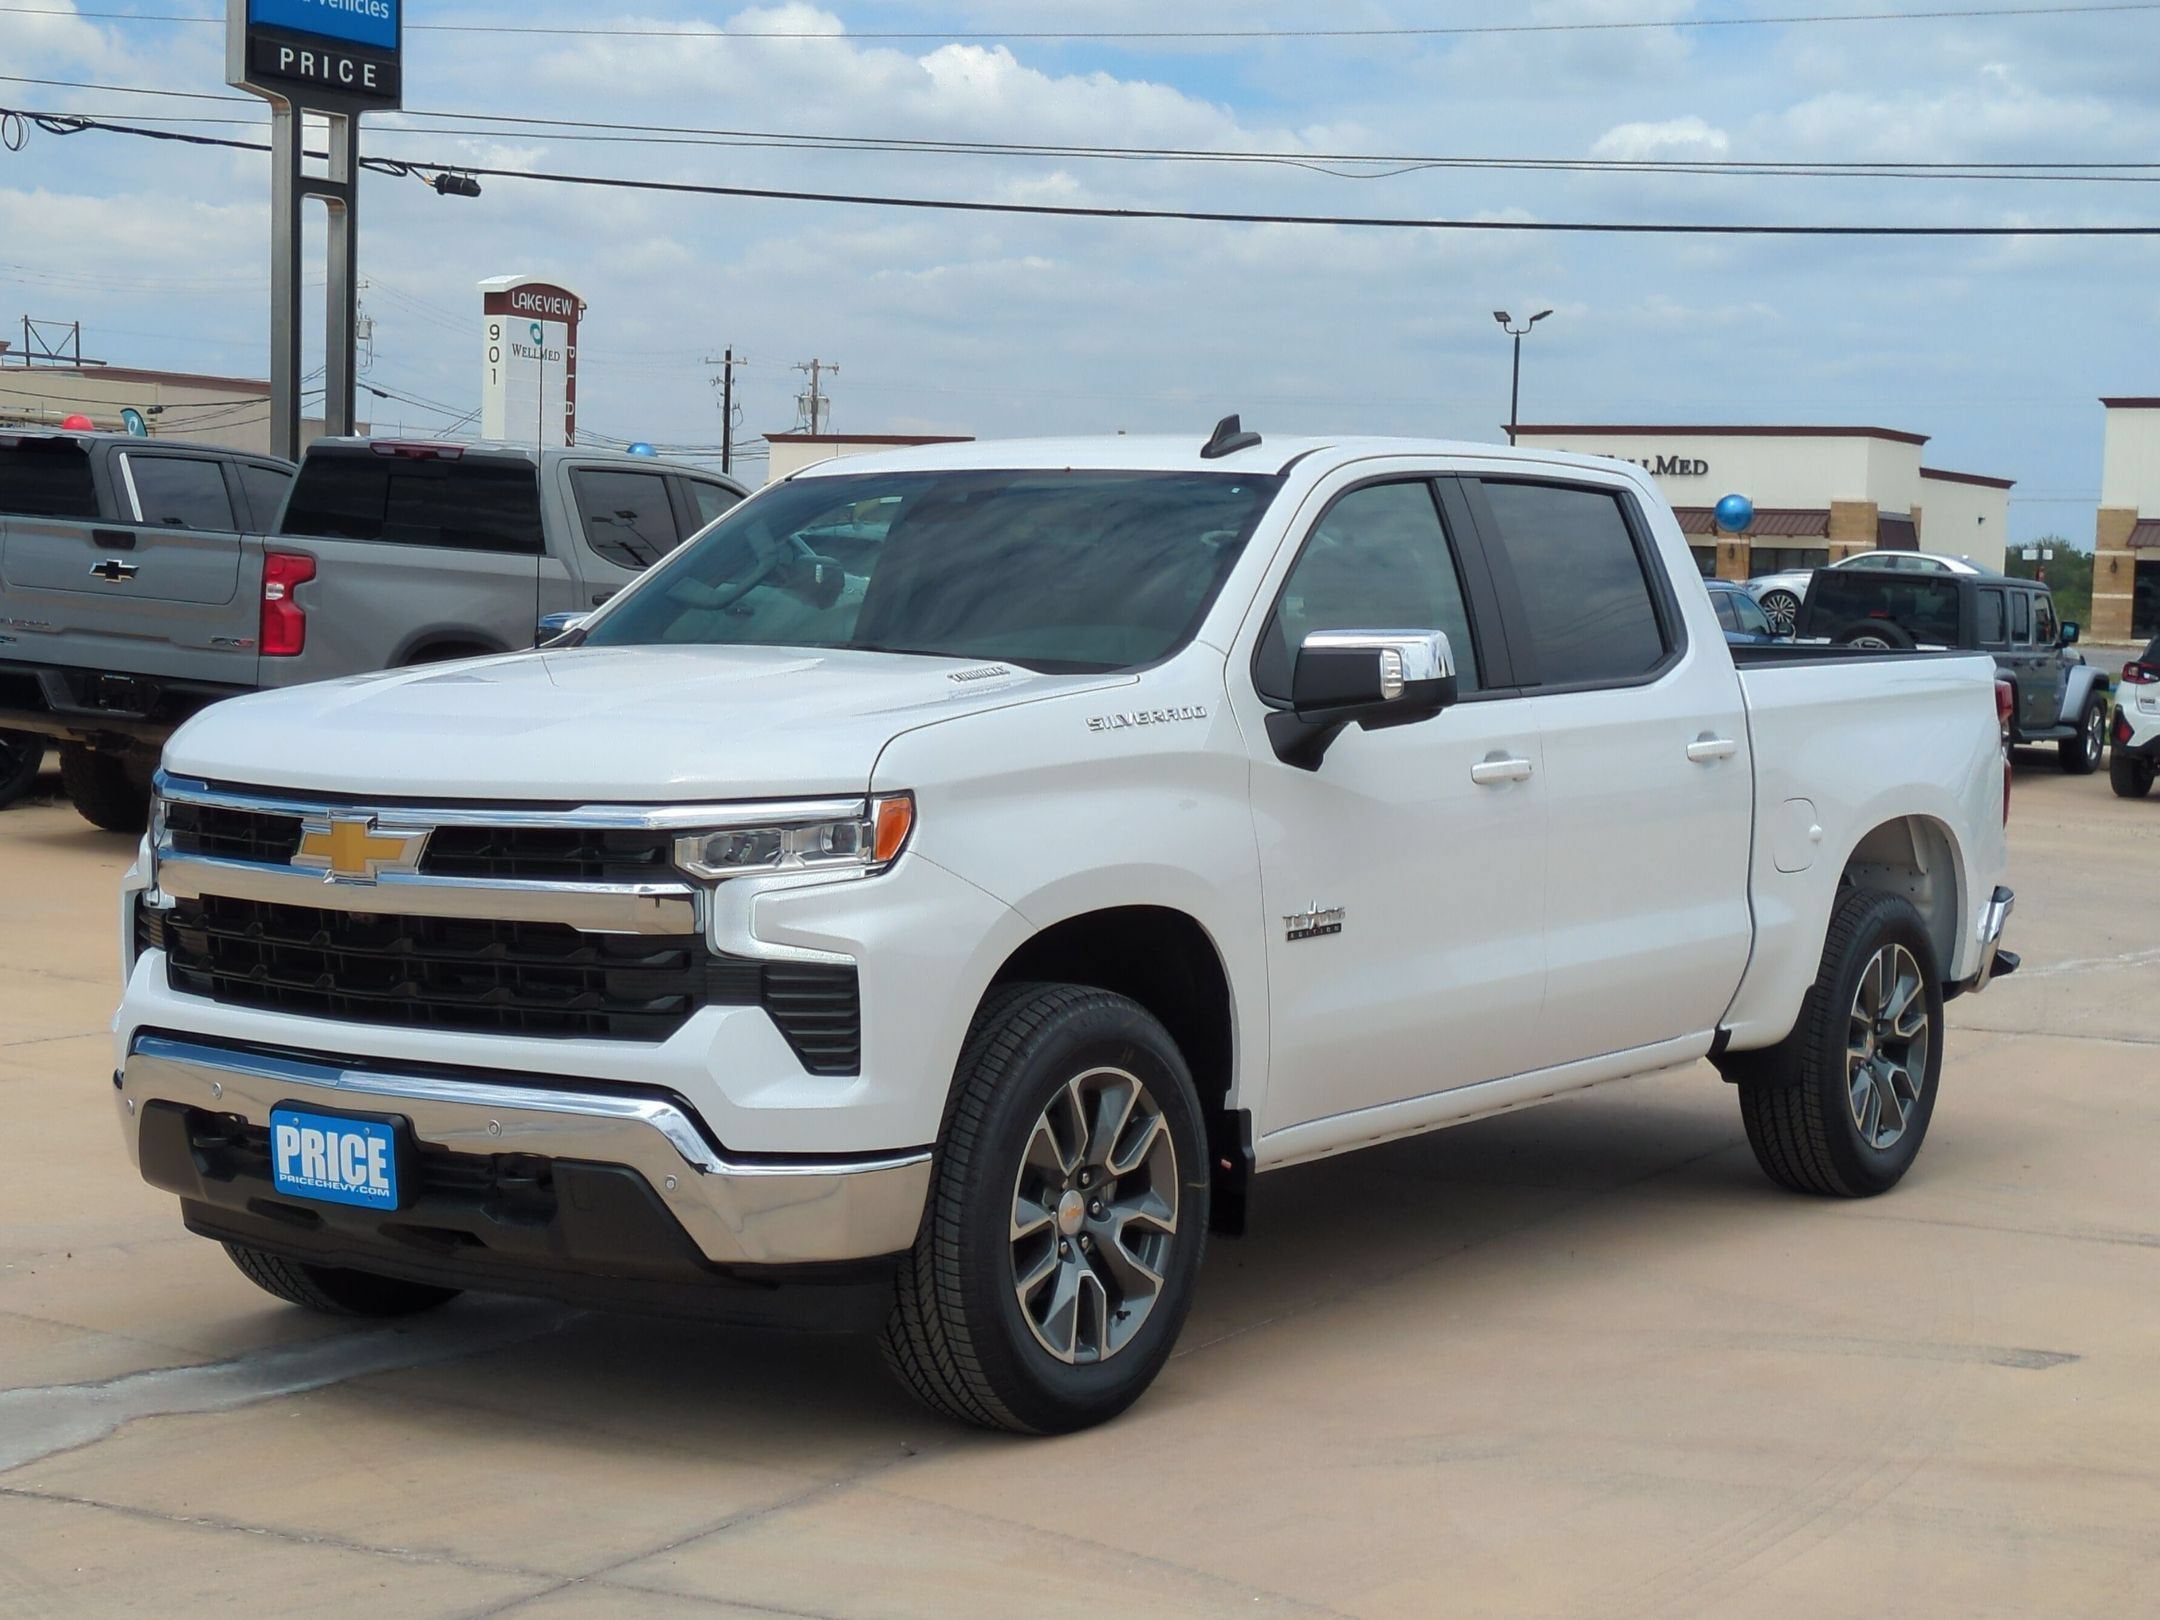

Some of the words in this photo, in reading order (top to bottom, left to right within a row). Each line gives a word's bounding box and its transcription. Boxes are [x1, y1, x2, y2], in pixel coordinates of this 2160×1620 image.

[319, 0, 389, 19] ehicles
[280, 47, 377, 88] PRICE
[512, 291, 572, 316] LAKEVIEW
[488, 323, 500, 385] 901
[1087, 705, 1207, 732] SILVERADO
[276, 1124, 390, 1189] PRICE
[279, 1173, 390, 1198] PRICECHEVY.COM
